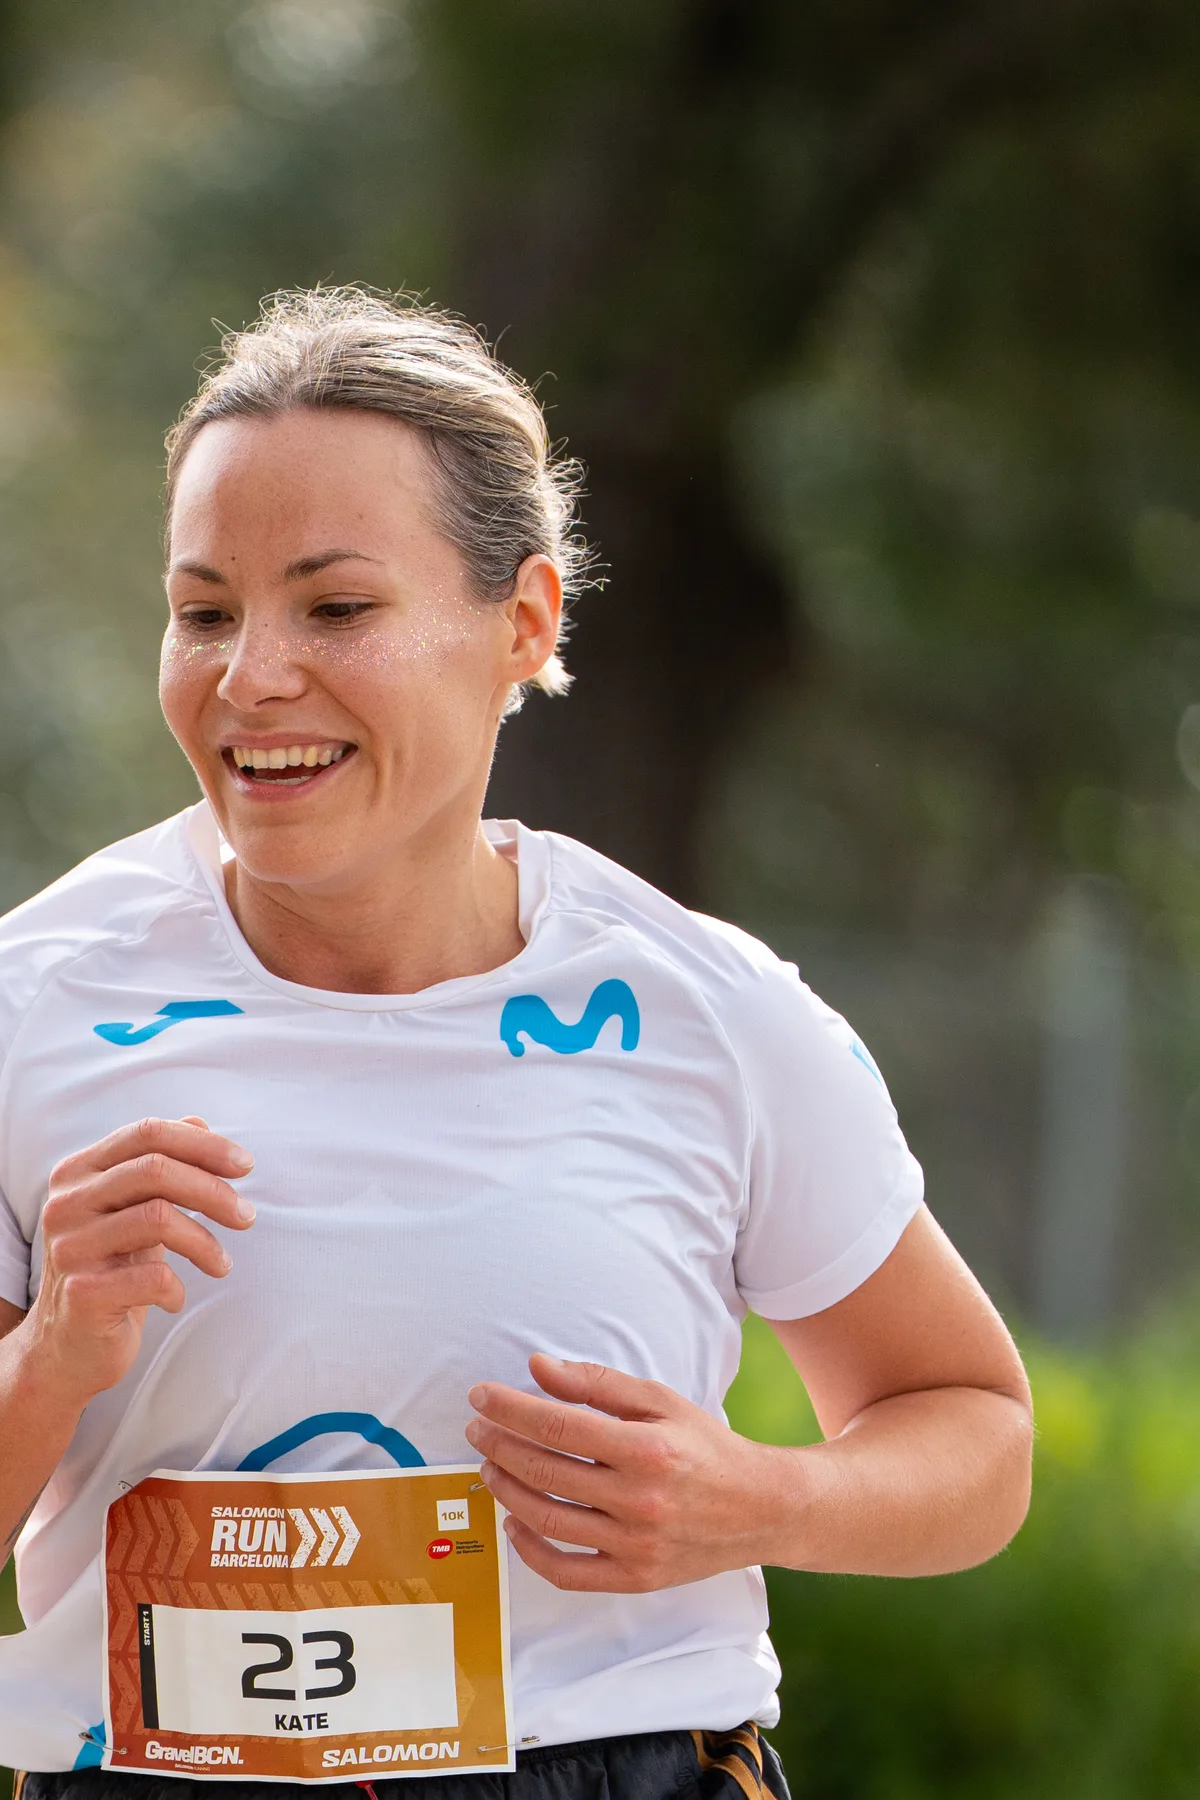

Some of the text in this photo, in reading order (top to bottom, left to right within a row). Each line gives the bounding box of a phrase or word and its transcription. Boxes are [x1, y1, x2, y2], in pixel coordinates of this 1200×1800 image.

[211, 1506, 285, 1518] SALOMON
[441, 1511, 465, 1521] 10K
[210, 1519, 287, 1552] RUN
[432, 1544, 451, 1553] TMB
[210, 1553, 289, 1568] BARCELONA
[143, 1616, 151, 1646] START
[241, 1630, 357, 1701] 23
[274, 1712, 329, 1731] KATE
[145, 1740, 244, 1765] GravelBCN.
[321, 1741, 460, 1768] SALOMON
